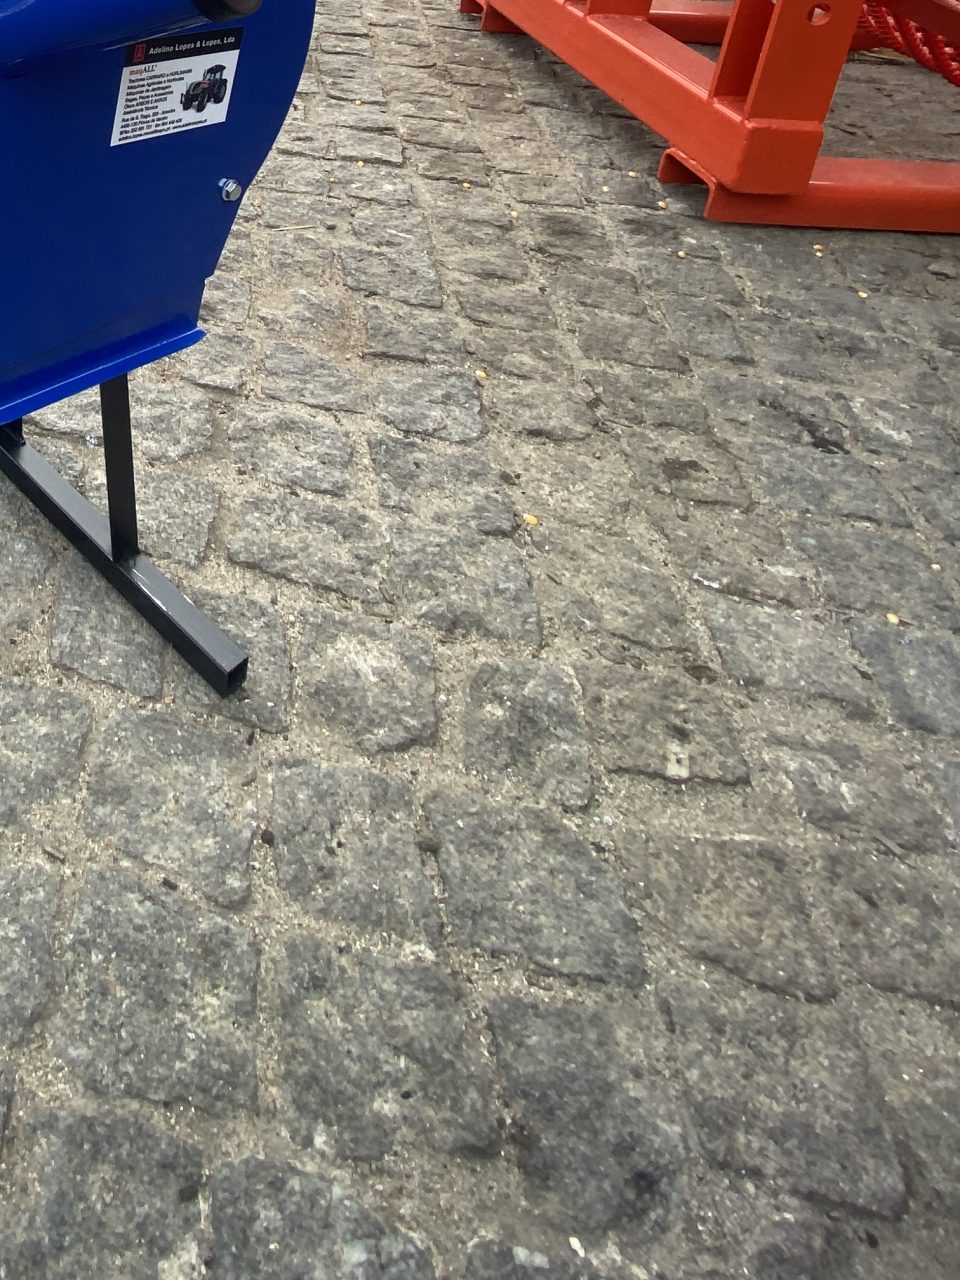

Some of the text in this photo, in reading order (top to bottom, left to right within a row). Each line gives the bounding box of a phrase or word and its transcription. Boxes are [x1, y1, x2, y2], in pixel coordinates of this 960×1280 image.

[149, 45, 173, 55] Adelino
[175, 43, 194, 51] Lopes
[202, 39, 222, 48] Lopes,
